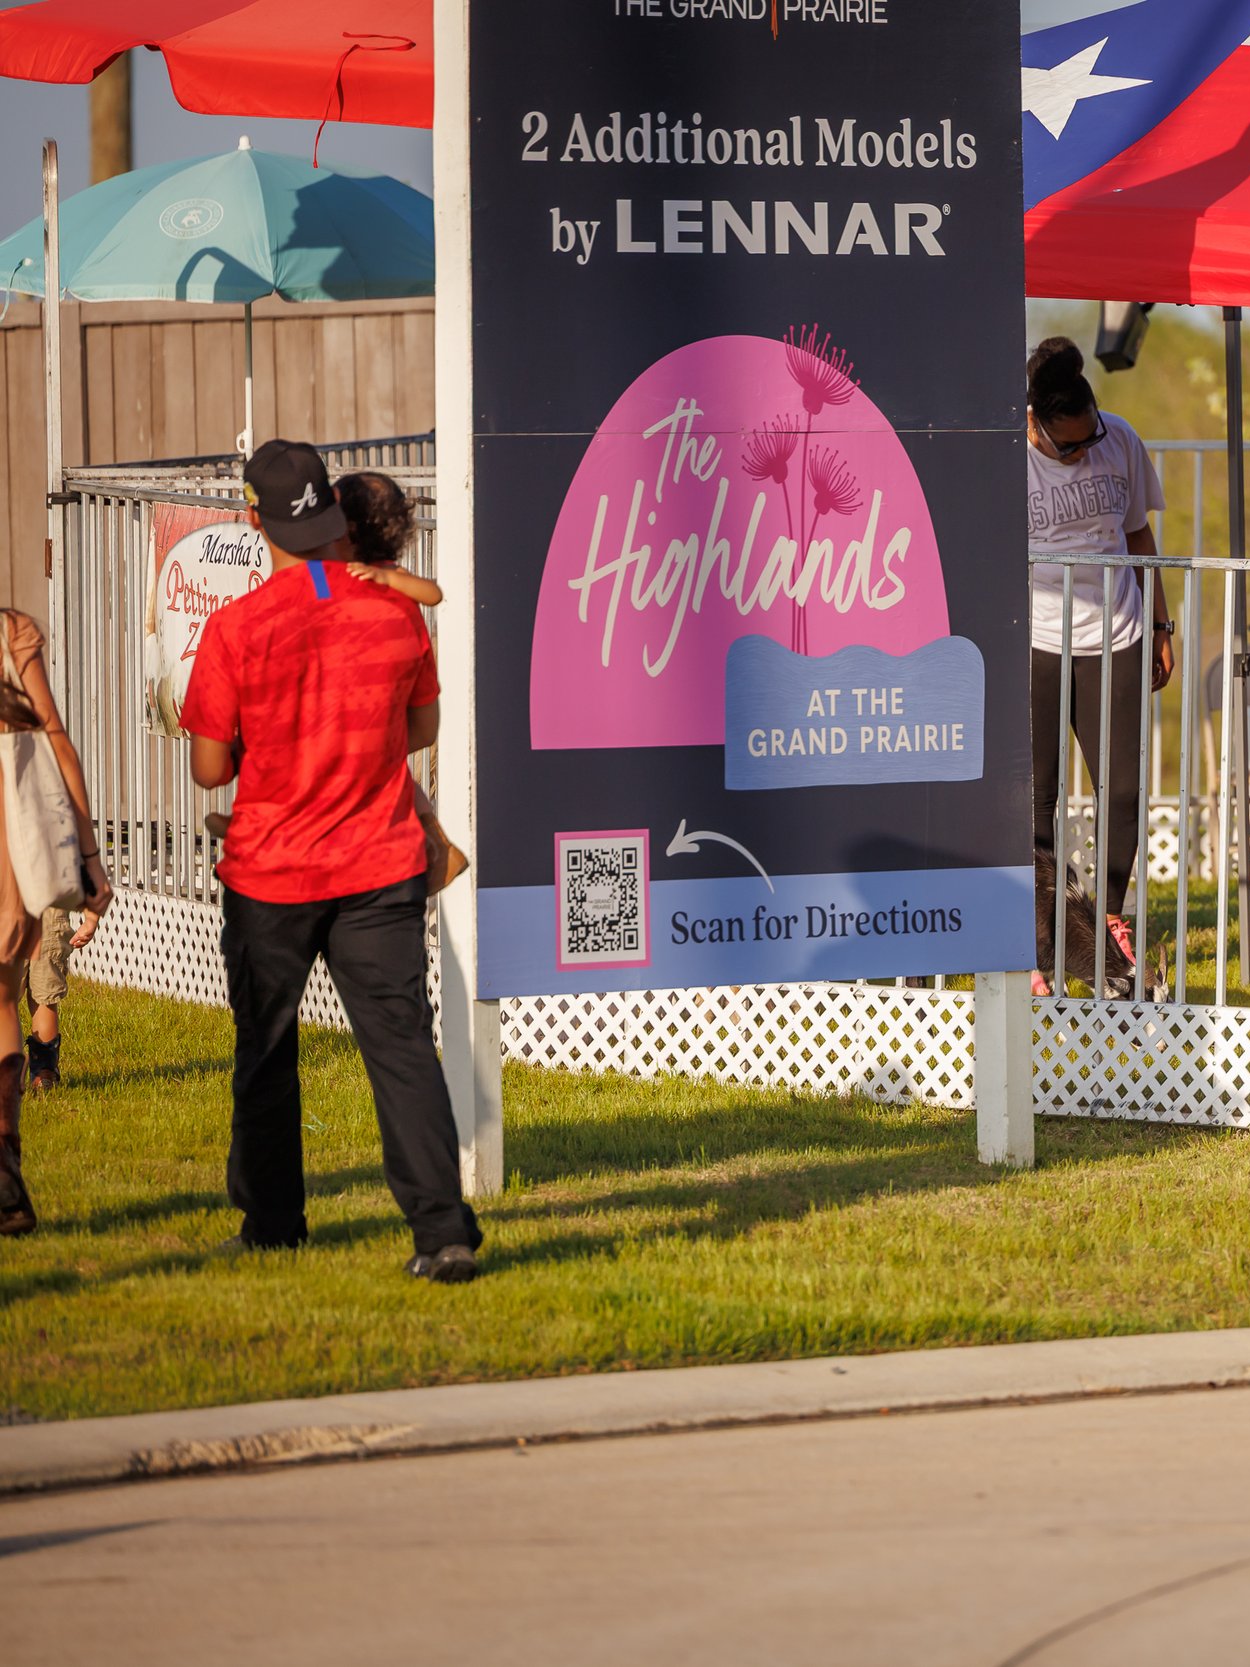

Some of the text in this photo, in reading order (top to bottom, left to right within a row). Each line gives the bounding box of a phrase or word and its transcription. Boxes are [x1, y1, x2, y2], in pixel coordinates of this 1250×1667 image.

[614, 0, 888, 23] THE GRAND PRAIRIE
[521, 111, 978, 168] 2 Additional Models
[549, 207, 600, 265] by
[643, 398, 722, 503] The
[199, 533, 263, 567] Marsha's
[568, 477, 912, 677] Highlands
[807, 687, 904, 717] AT THE
[747, 723, 965, 757] GRAND PRAIRIE
[671, 900, 963, 945] Scan for Directions
